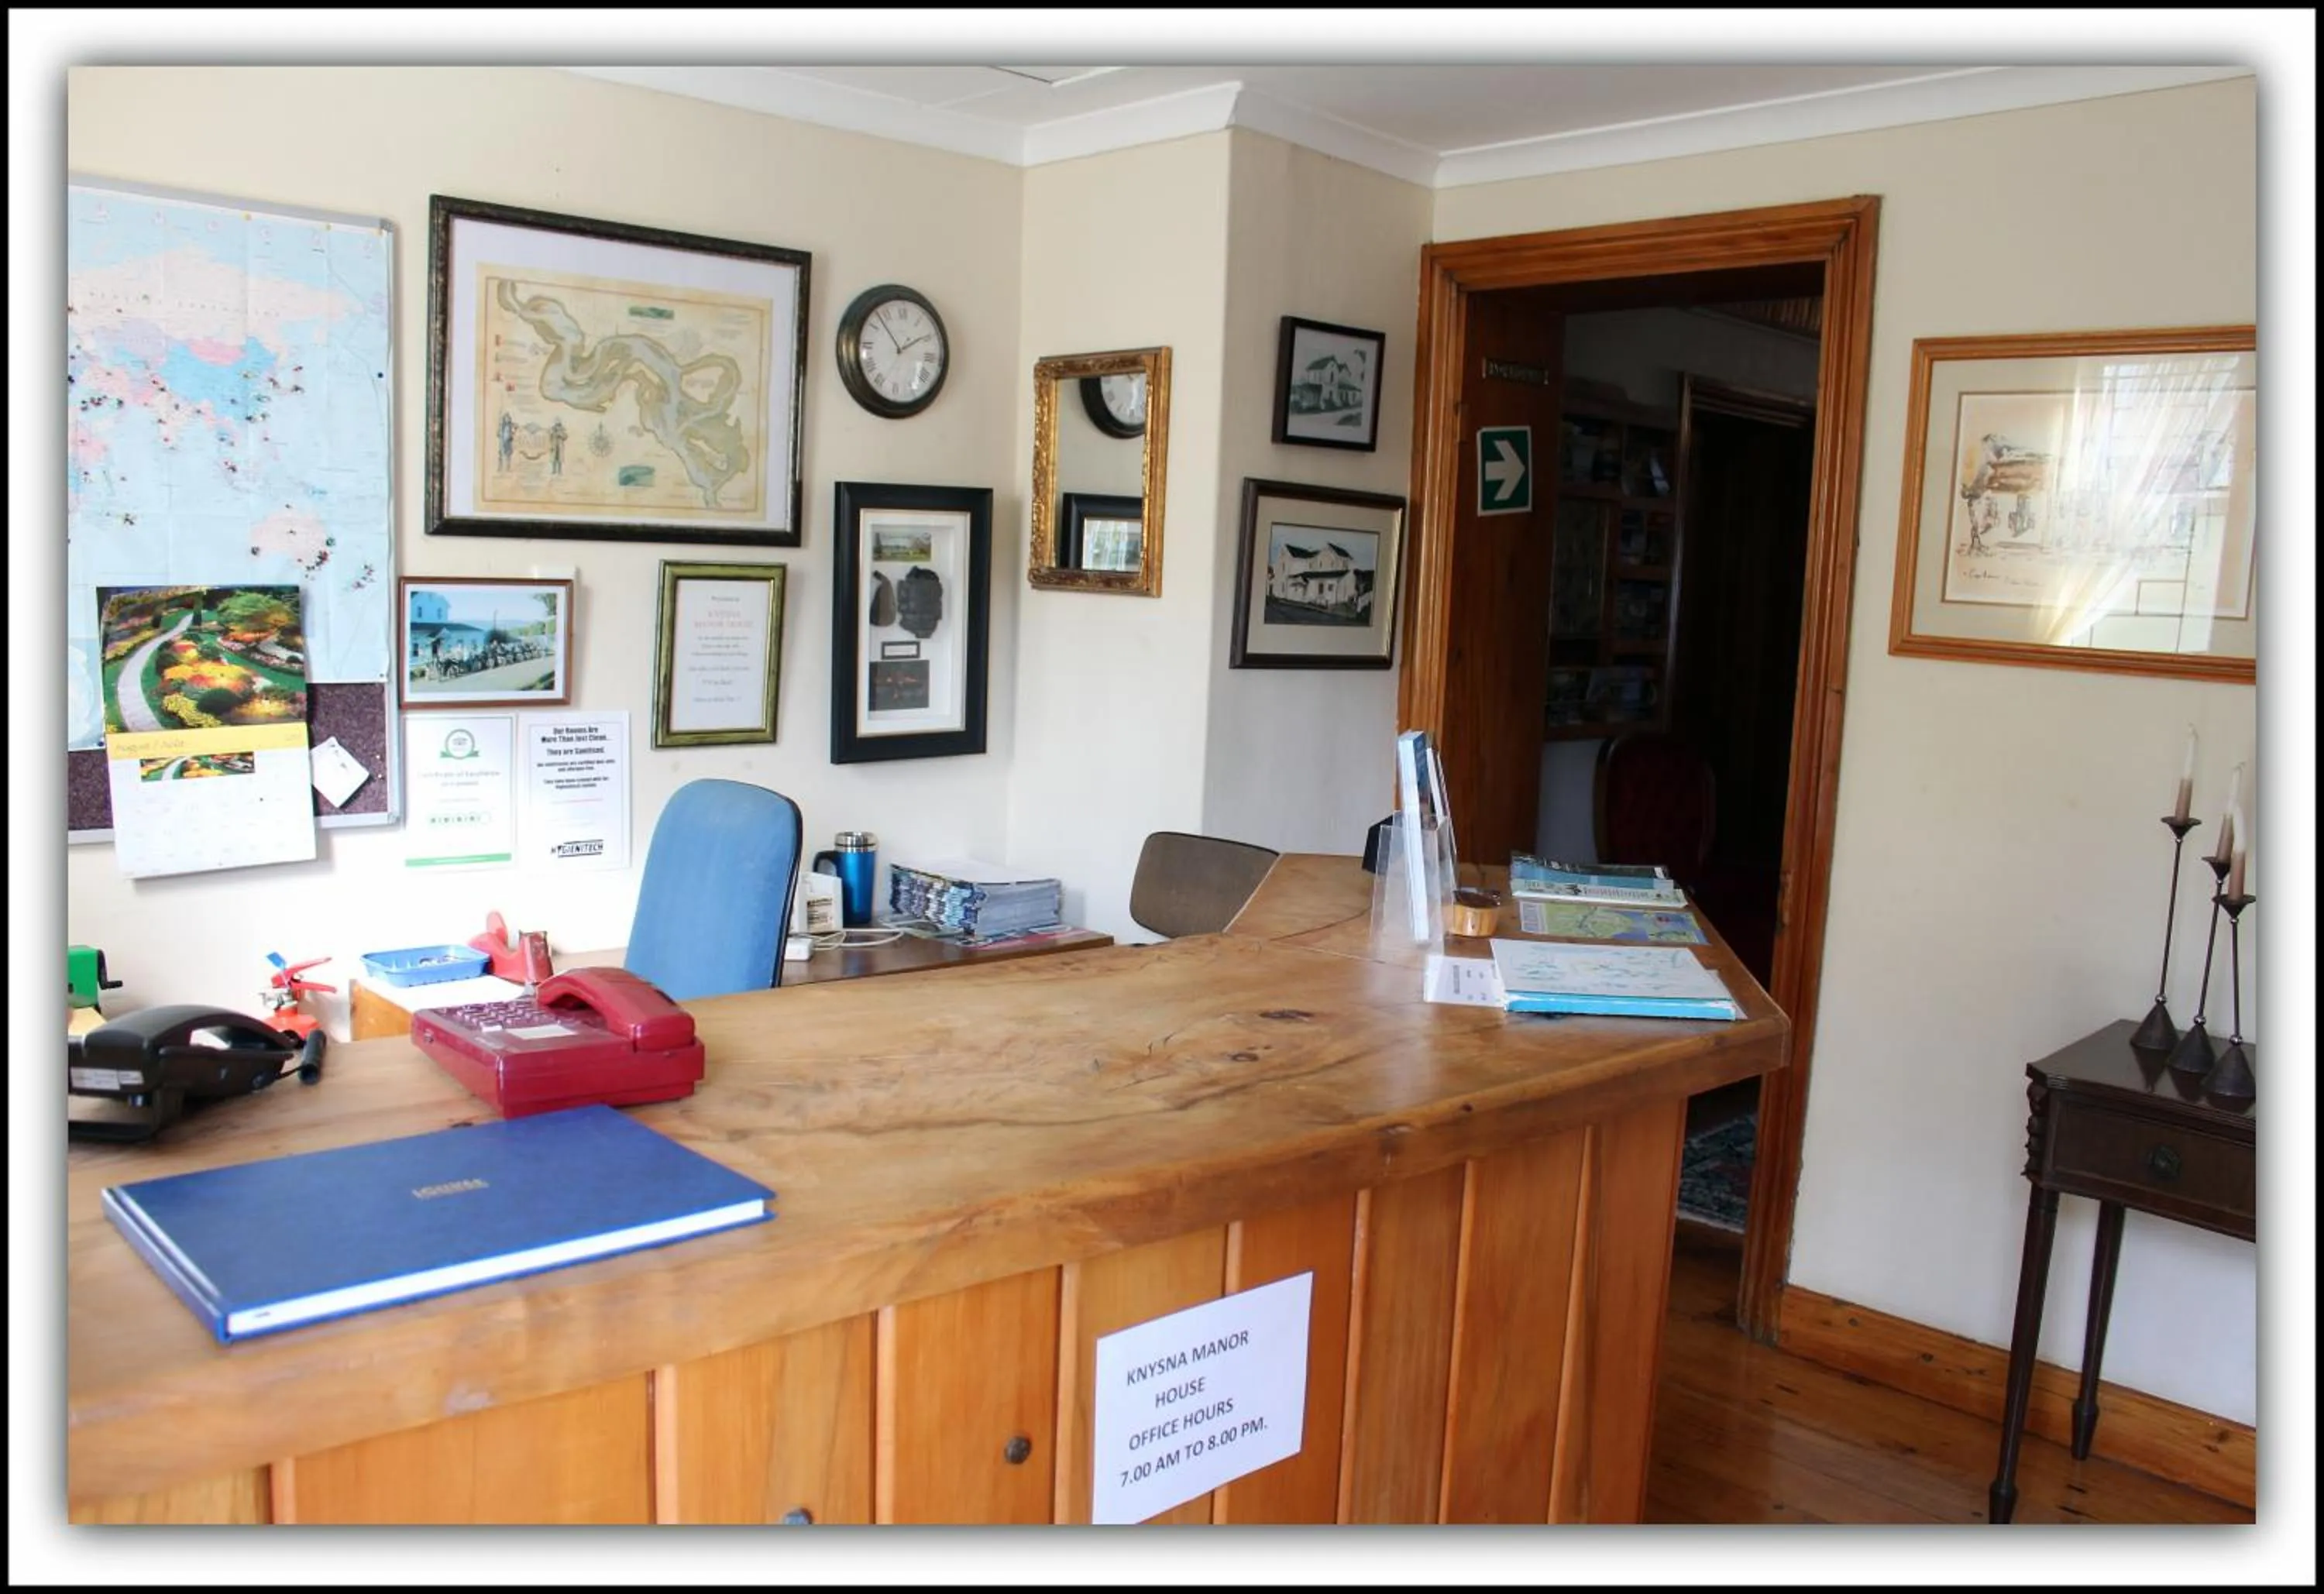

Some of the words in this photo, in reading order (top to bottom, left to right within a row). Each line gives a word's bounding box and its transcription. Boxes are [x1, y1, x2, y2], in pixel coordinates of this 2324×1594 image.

[1126, 1352, 1188, 1386] KNYSNA
[1191, 1330, 1249, 1363] MANOR
[1155, 1376, 1206, 1409] HOUSE
[1129, 1418, 1179, 1451] OFFICE
[1183, 1397, 1234, 1431] HOURS
[1120, 1462, 1152, 1488] 7.00
[1155, 1450, 1181, 1473] AM
[1185, 1440, 1205, 1458] TO
[1208, 1427, 1238, 1451] 8.00
[1240, 1416, 1268, 1439] PM.
